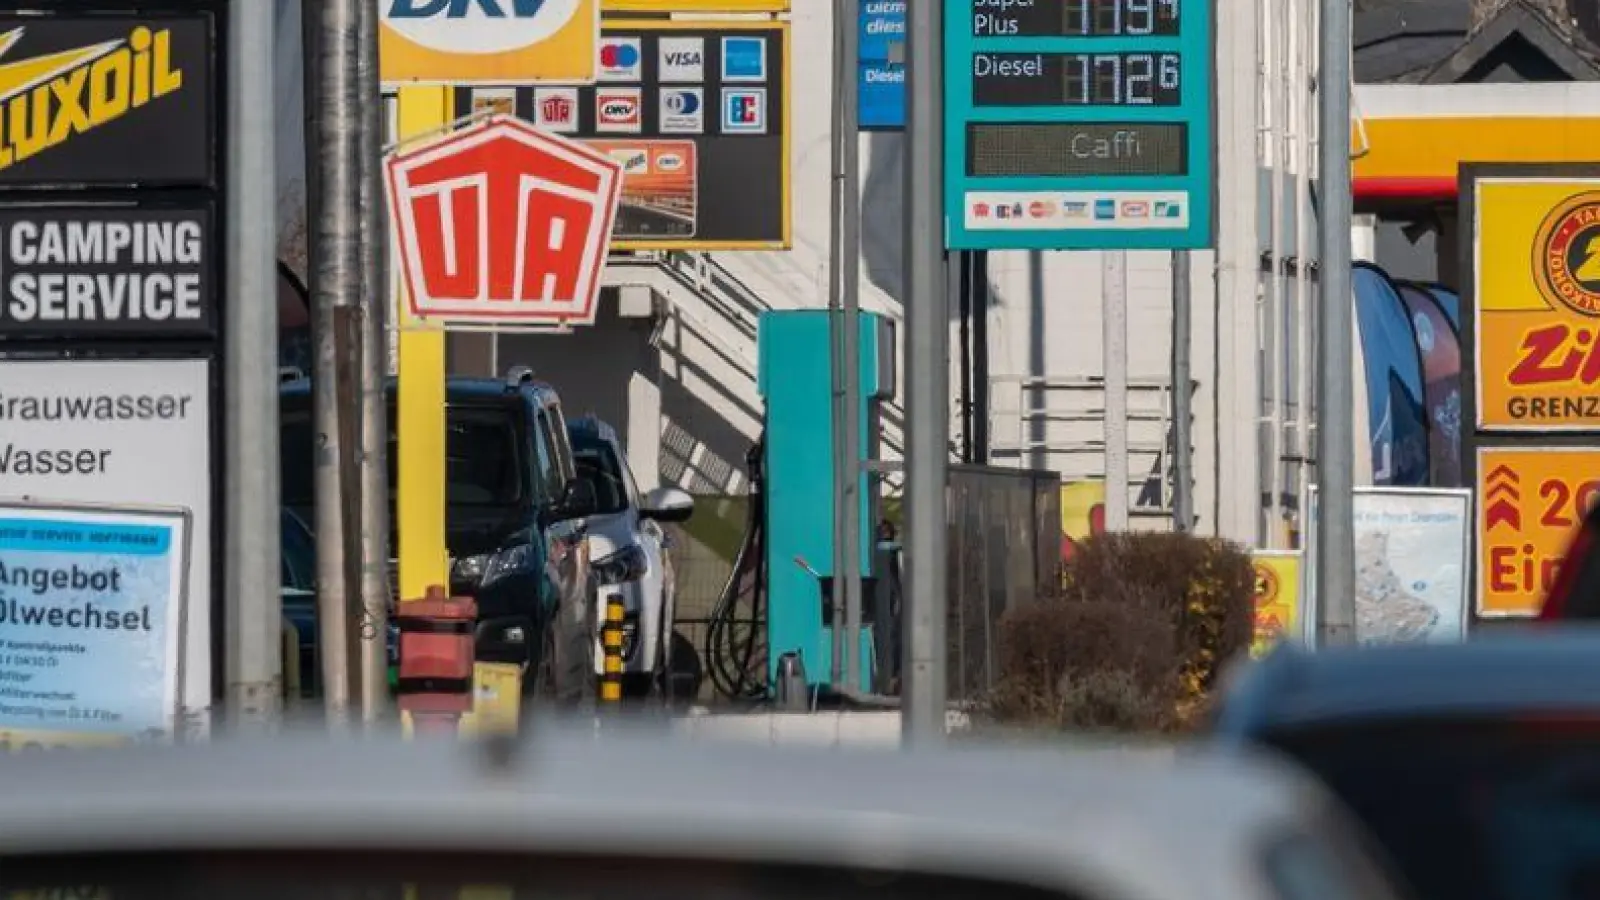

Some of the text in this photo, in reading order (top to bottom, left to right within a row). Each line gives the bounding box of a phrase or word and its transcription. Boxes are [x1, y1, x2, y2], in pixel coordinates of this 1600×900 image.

[974, 14, 1019, 34] Plus
[664, 52, 701, 66] VISA
[974, 55, 1043, 76] Diesel
[406, 133, 602, 302] UTA
[9, 220, 201, 265] CAMPING
[9, 273, 201, 321] SERVICE
